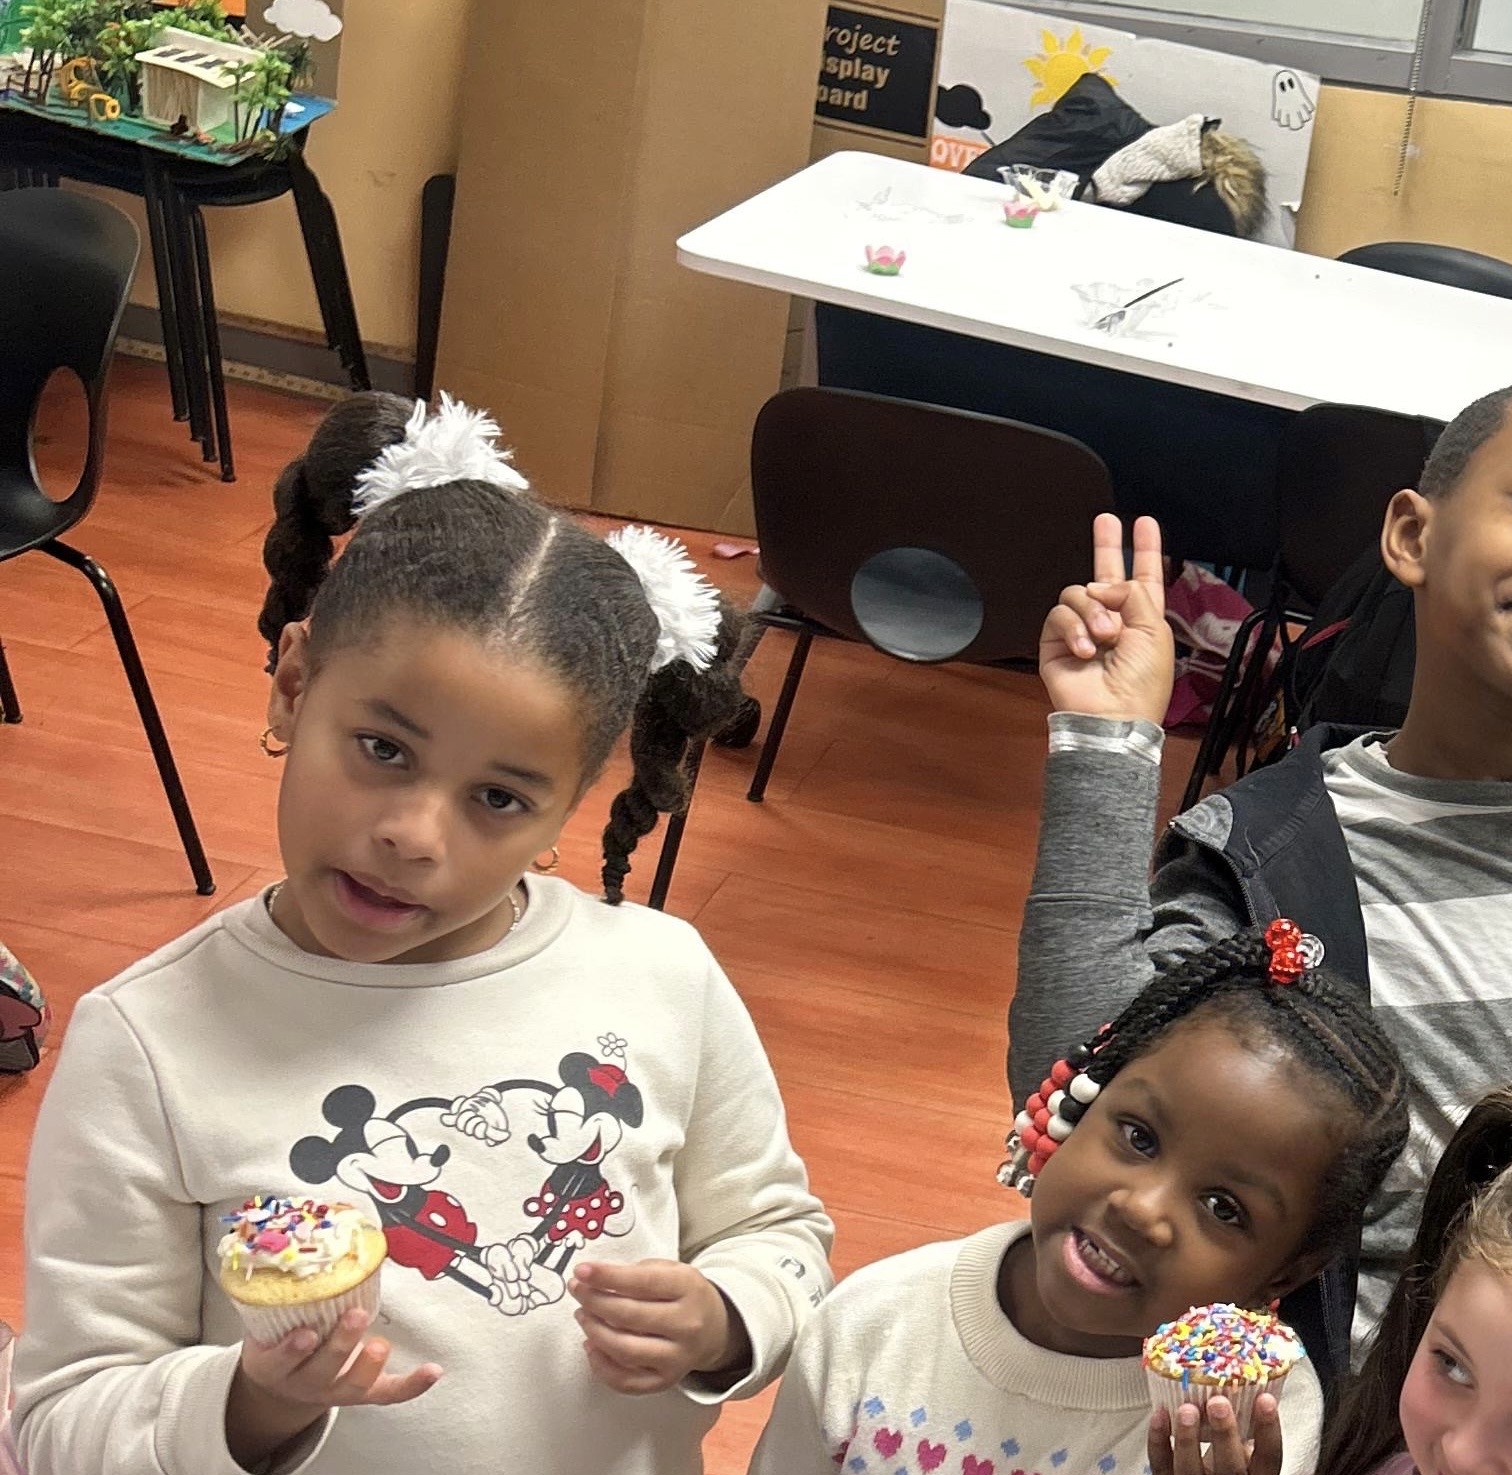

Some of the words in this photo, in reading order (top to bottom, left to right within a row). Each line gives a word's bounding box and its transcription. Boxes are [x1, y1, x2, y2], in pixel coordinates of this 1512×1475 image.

[826, 24, 900, 56] roject
[825, 56, 890, 89] splay
[818, 84, 869, 111] oard
